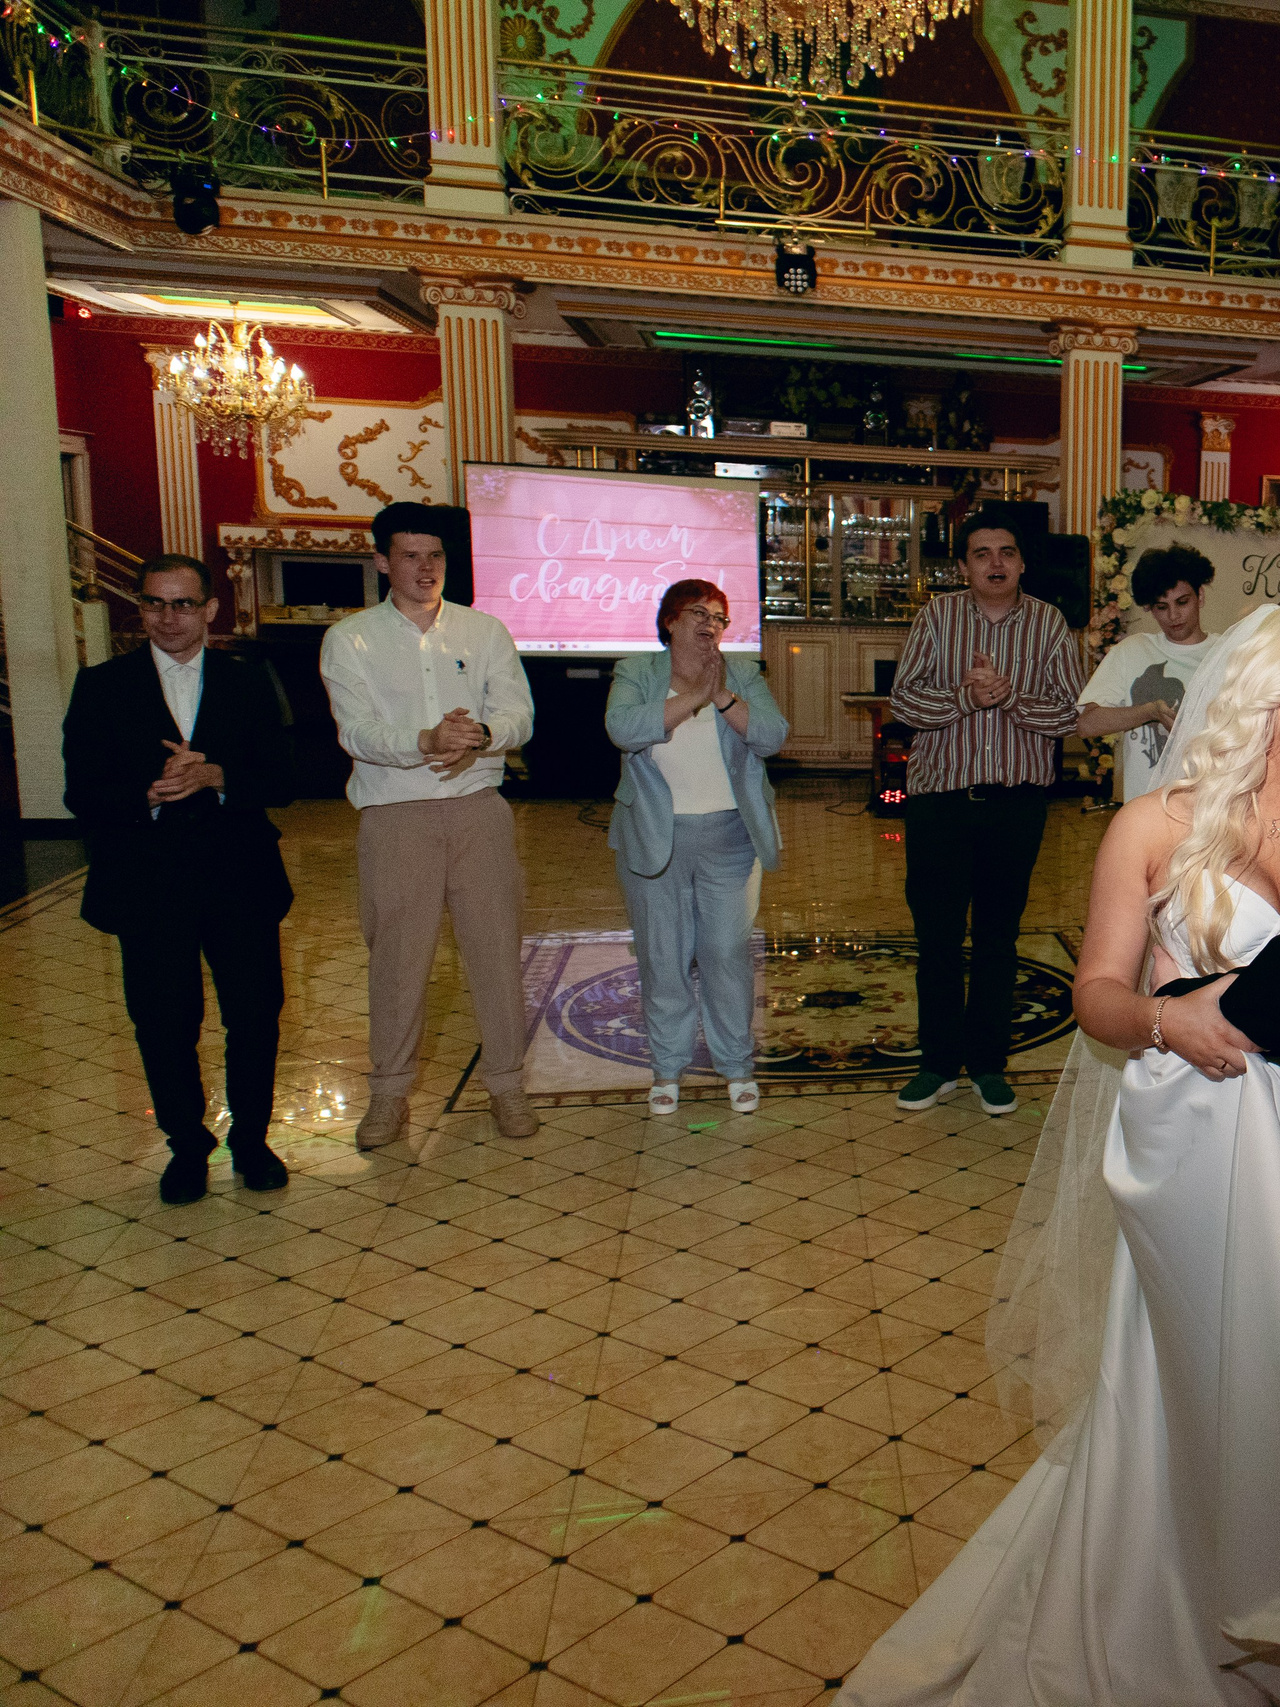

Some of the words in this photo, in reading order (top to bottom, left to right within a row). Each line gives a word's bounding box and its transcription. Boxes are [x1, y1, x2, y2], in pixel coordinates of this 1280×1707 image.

[536, 513, 570, 557] С
[577, 518, 697, 562] Днем
[509, 559, 725, 612] свадьб!
